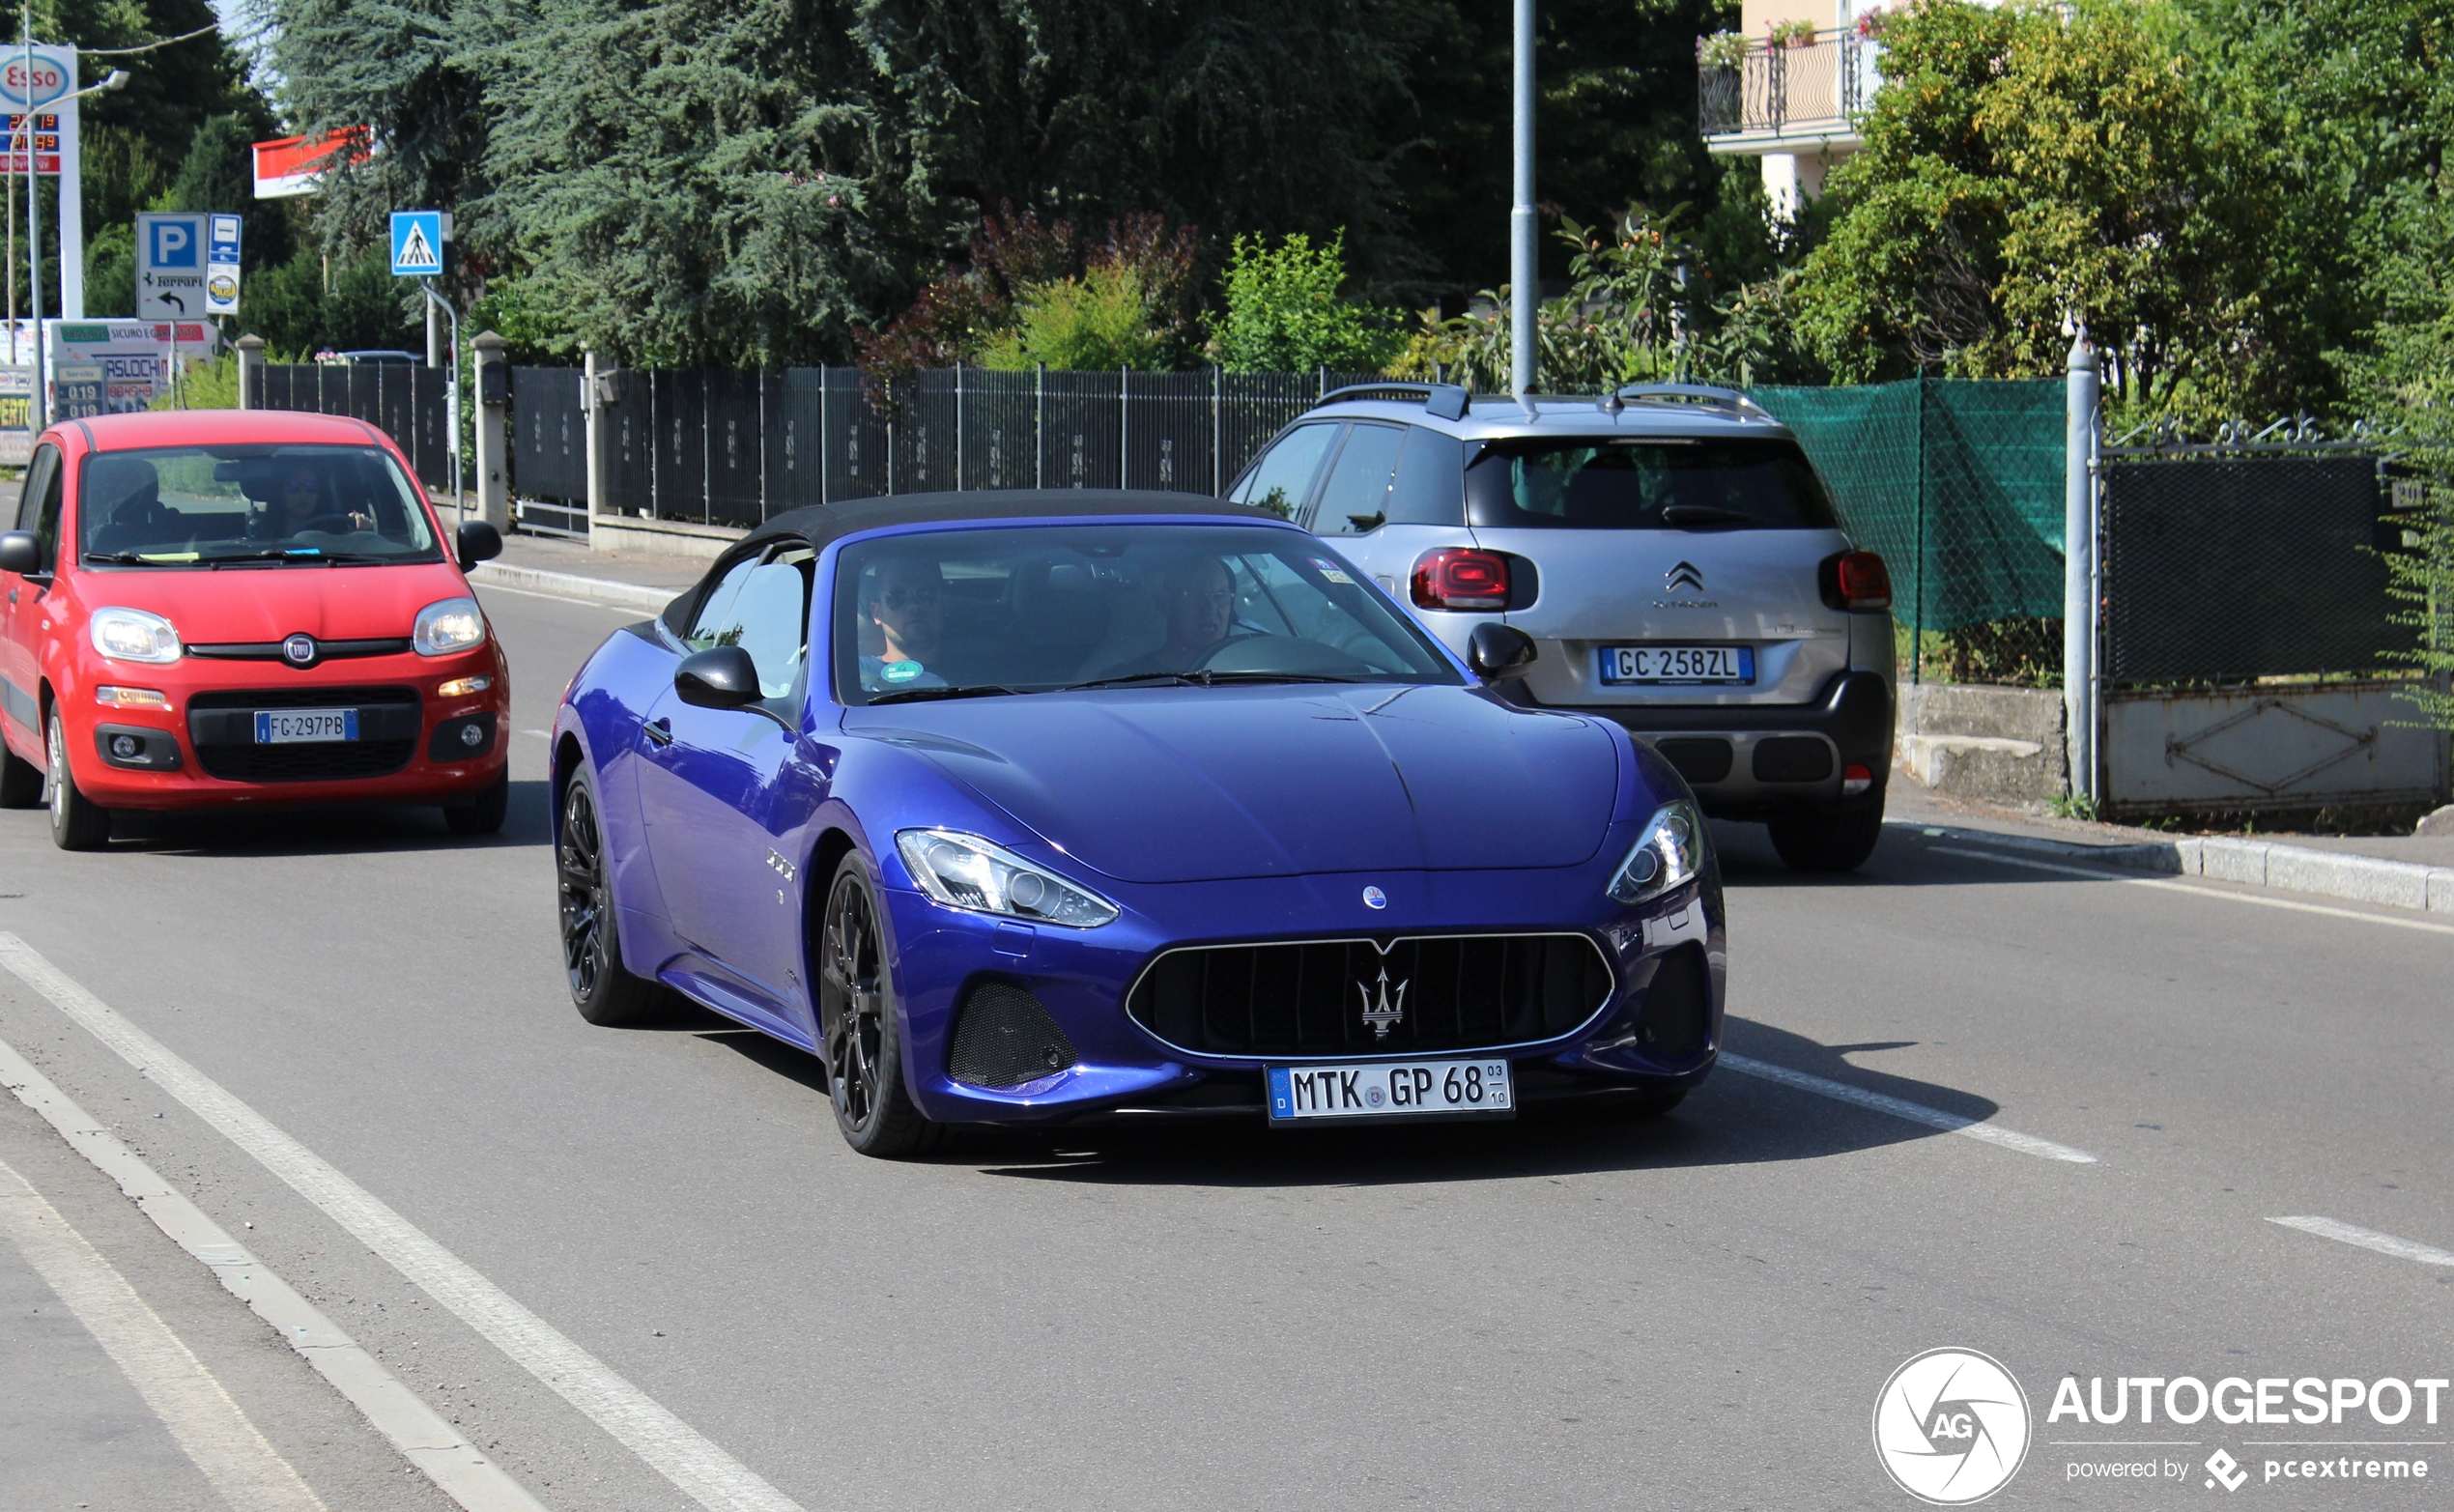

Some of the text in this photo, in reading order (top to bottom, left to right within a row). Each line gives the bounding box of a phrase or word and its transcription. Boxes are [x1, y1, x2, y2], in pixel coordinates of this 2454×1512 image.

[7, 66, 57, 87] Esso
[158, 225, 187, 263] P
[157, 276, 203, 287] Ferrari
[111, 329, 142, 338] SICURO
[294, 644, 308, 655] FIAT
[1488, 1066, 1502, 1076] 03
[1277, 1066, 1483, 1110] D MTK GP 68
[1490, 1092, 1505, 1103] 10
